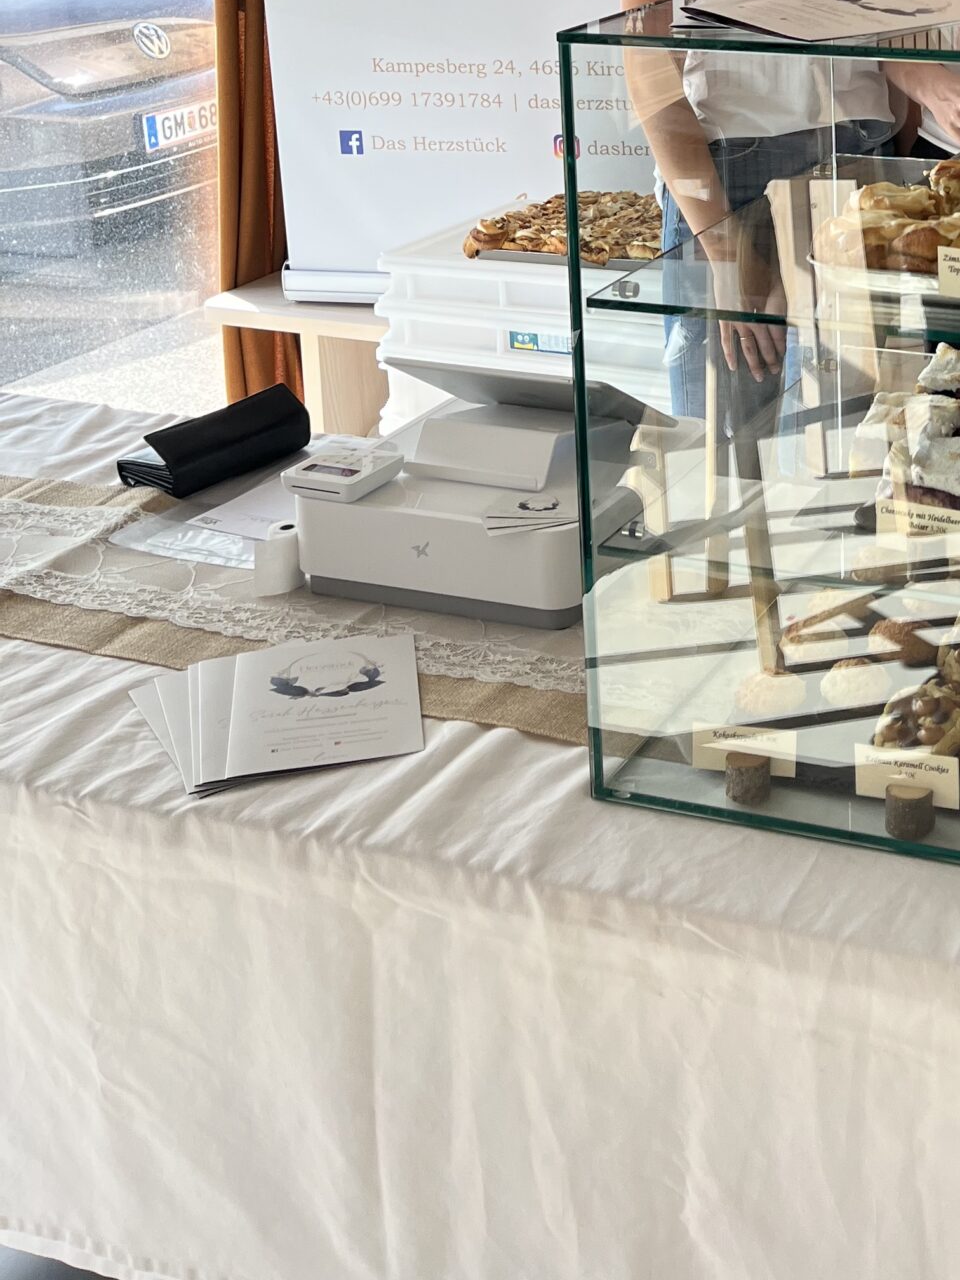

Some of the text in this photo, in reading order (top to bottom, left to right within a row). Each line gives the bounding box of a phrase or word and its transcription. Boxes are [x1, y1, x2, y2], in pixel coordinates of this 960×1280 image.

[371, 57, 488, 79] Kampesberg
[493, 59, 523, 77] 24,
[311, 90, 403, 110] +43(0)699
[410, 91, 504, 108] 17391784
[161, 111, 186, 140] GM
[371, 135, 508, 153] Das Herzstück
[893, 759, 924, 771] Karamell
[924, 763, 950, 775] Cookies
